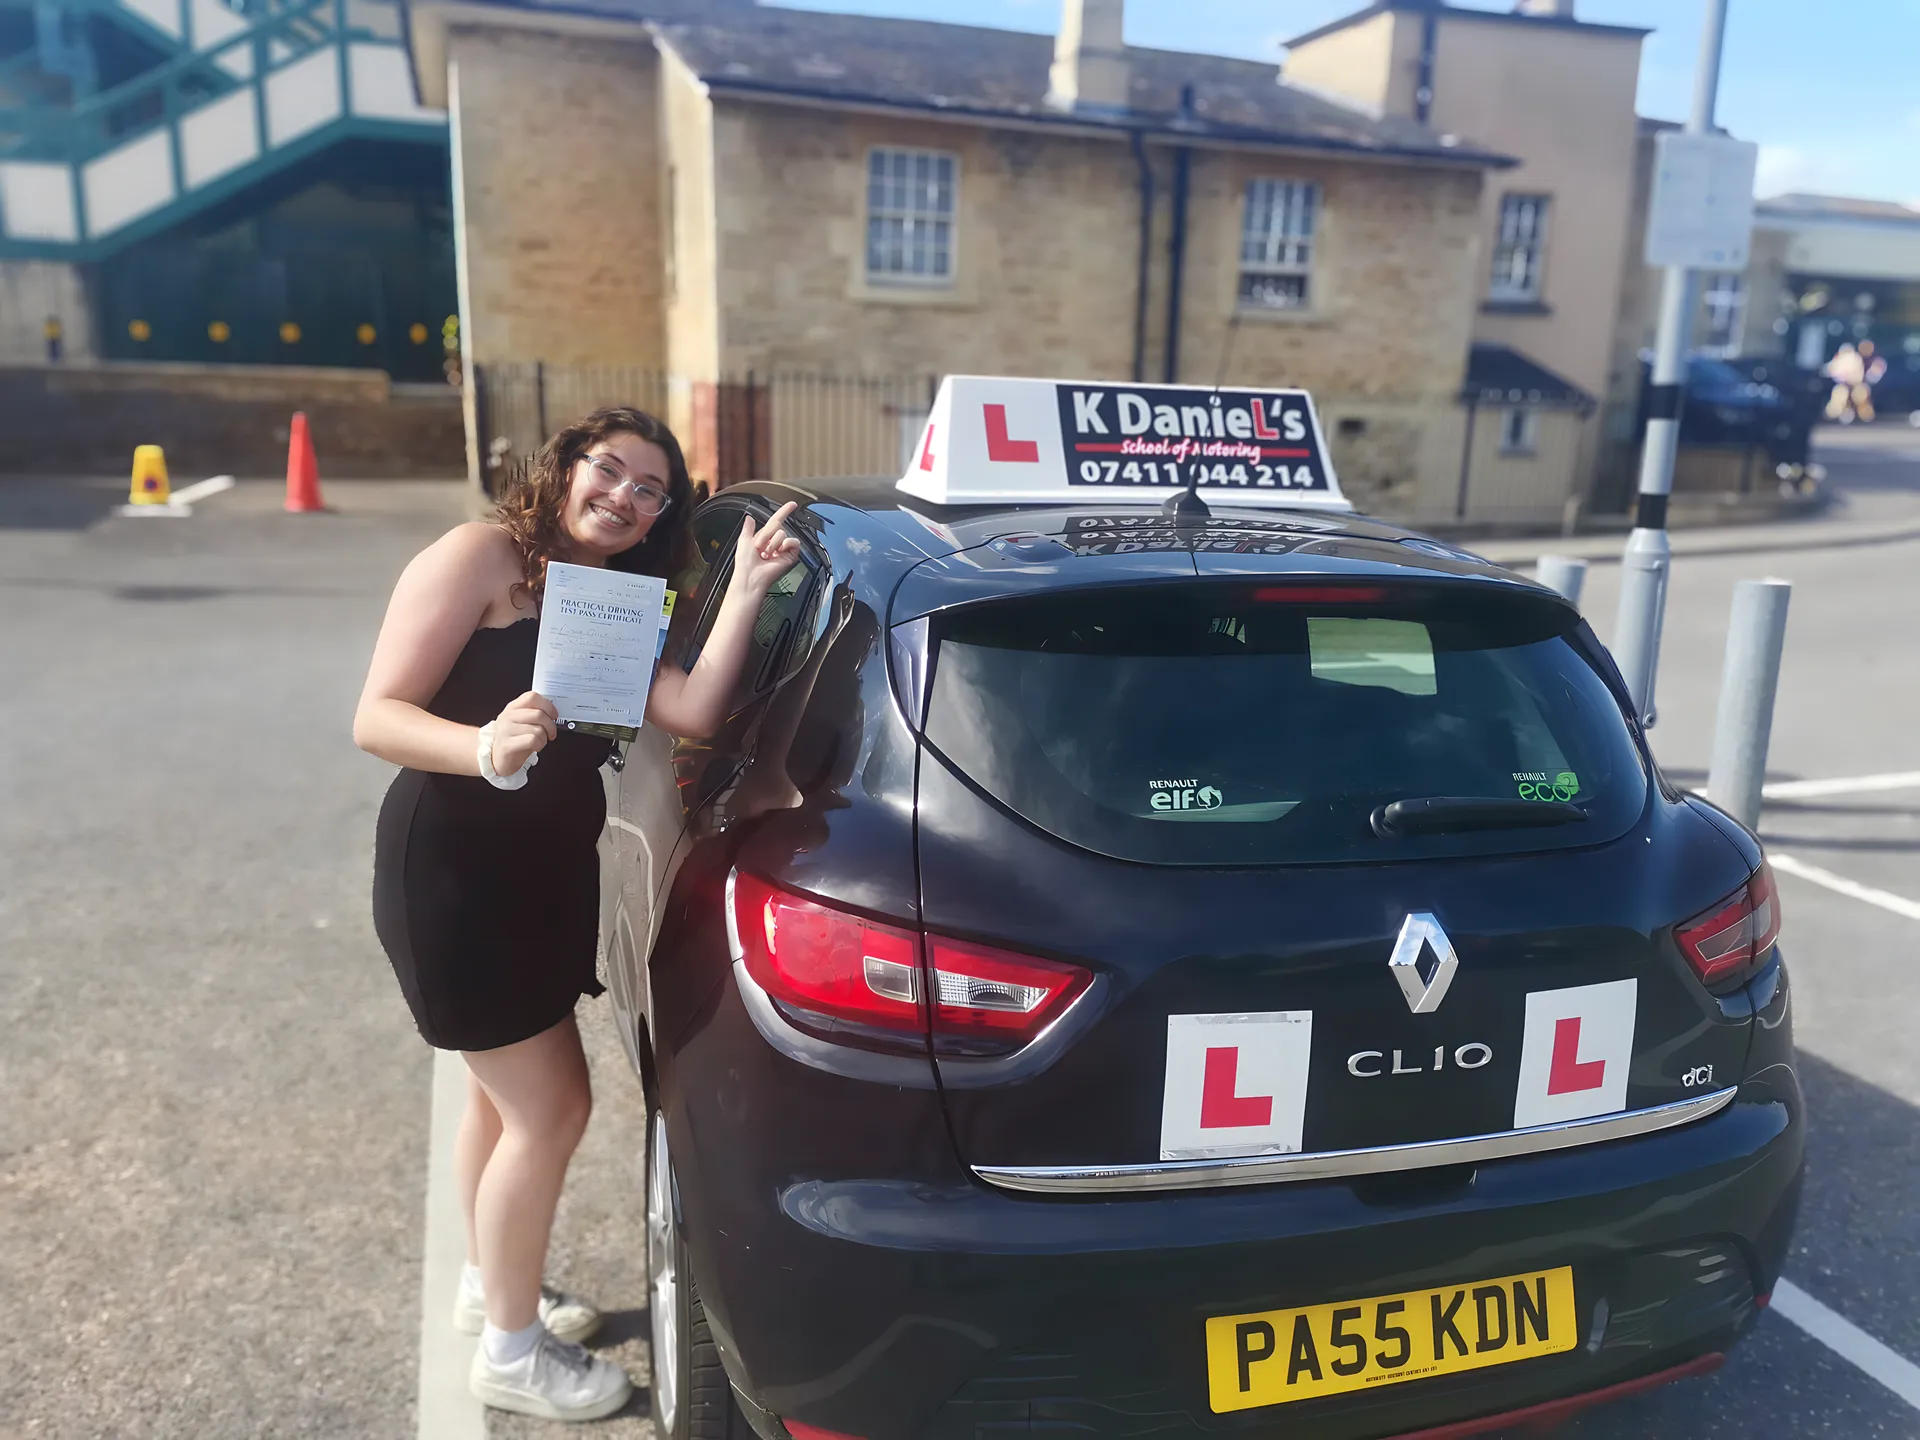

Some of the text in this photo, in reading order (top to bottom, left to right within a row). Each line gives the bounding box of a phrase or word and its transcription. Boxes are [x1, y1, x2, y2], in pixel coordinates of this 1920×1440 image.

[1073, 391, 1110, 434] K
[983, 403, 1040, 463] L
[1120, 436, 1170, 455] School
[1171, 436, 1191, 464] of
[1080, 460, 1179, 484] 07411
[1255, 464, 1314, 487] 214
[561, 599, 644, 618] PRACTICAL DRIVING
[579, 610, 596, 618] PASS
[598, 613, 642, 624] CERTIFICATE
[1149, 779, 1198, 789] RENAULT
[1512, 772, 1547, 781] RENAULT
[1150, 789, 1195, 810] elf
[1347, 1042, 1493, 1078] CLIO
[1547, 1017, 1606, 1095] L
[1200, 1046, 1273, 1129] L
[1235, 1276, 1551, 1393] PA55 KDN
